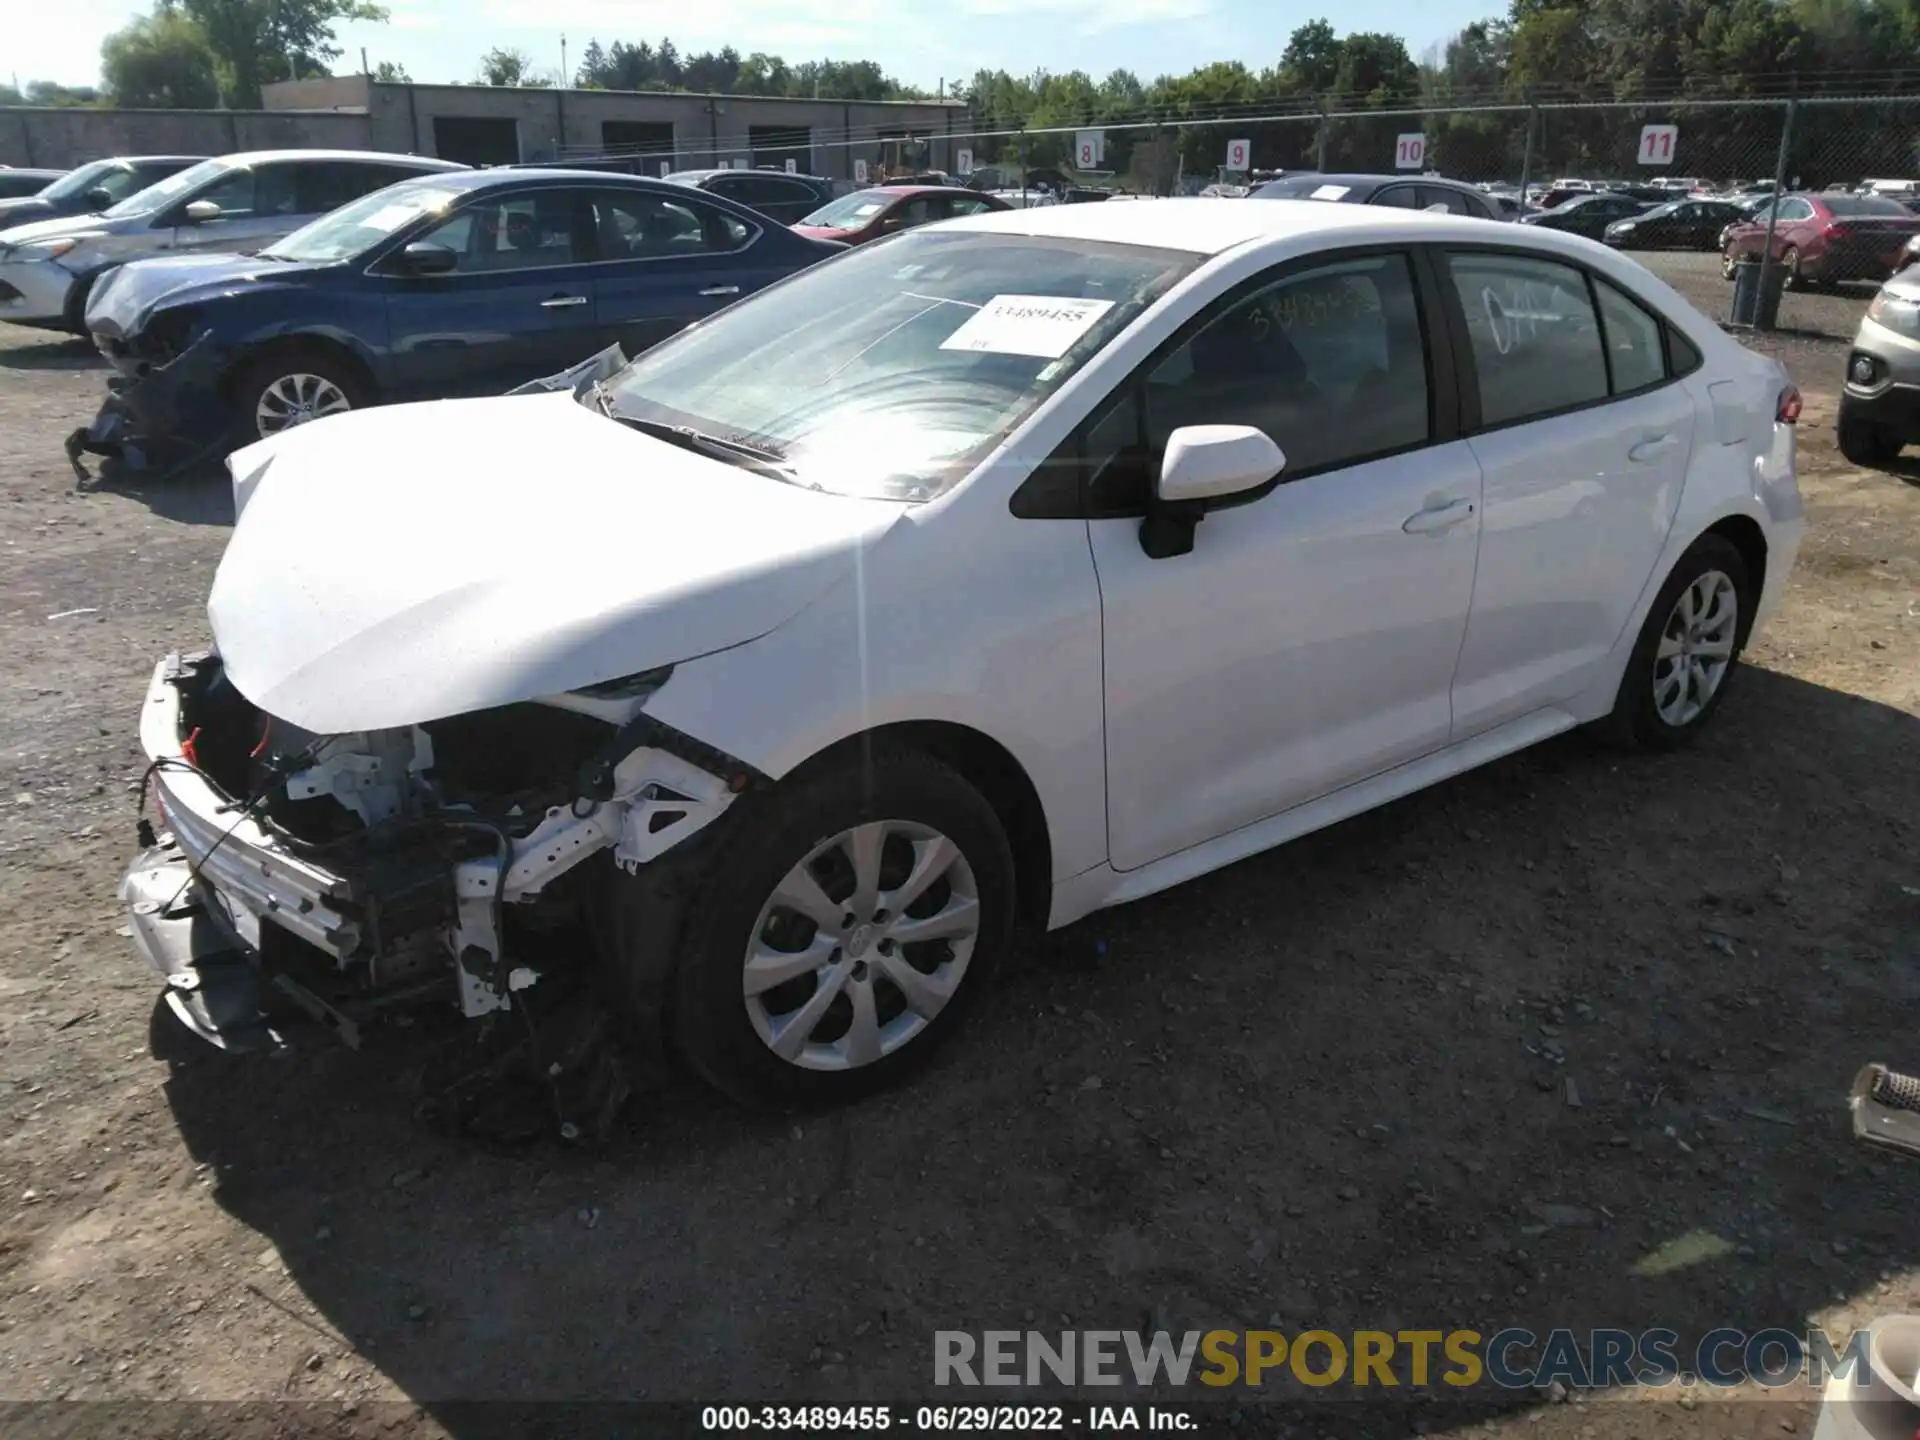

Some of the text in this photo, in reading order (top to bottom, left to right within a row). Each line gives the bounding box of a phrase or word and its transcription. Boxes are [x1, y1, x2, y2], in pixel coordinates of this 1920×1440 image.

[1082, 145, 1091, 163] 8
[1400, 141, 1422, 161] 10
[1645, 132, 1671, 157] 11
[961, 153, 969, 171] 7
[1233, 145, 1244, 165] 9
